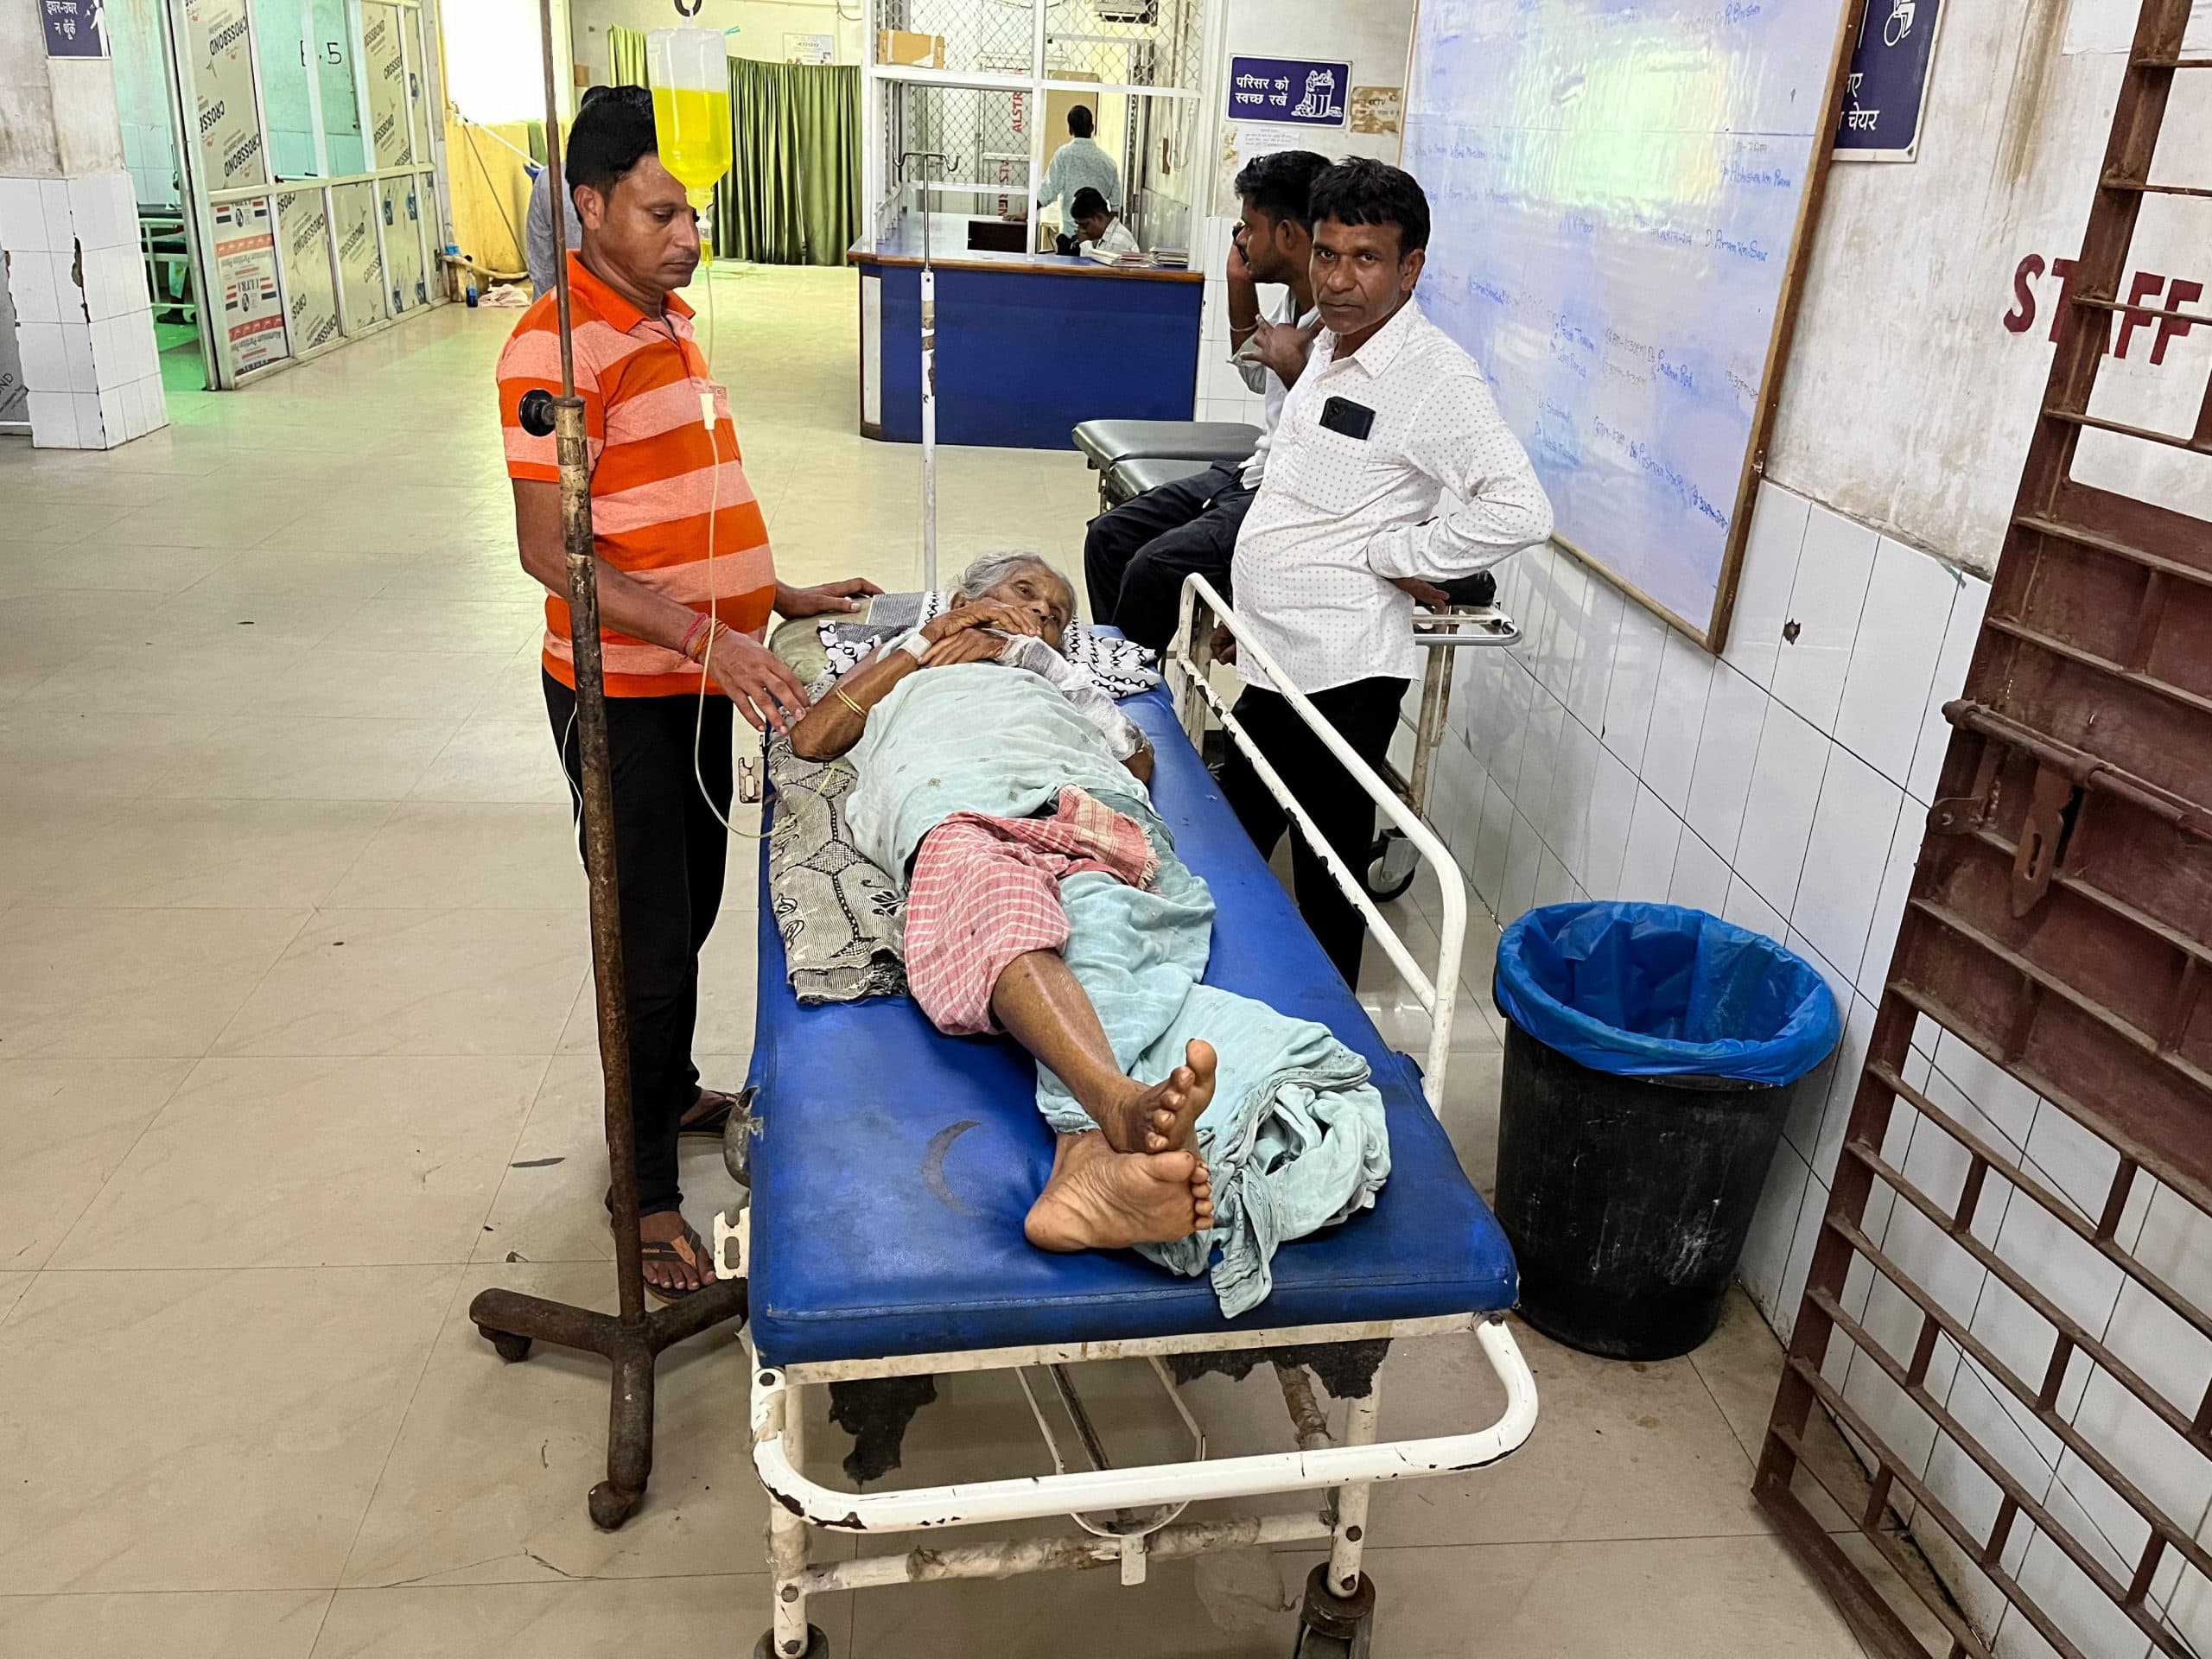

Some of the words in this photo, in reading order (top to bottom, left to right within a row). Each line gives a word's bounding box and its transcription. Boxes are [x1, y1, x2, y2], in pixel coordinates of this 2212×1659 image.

[54, 22, 61, 35] न
[209, 16, 249, 56] CROSSBOND
[1236, 74, 1269, 89] परिसर
[1274, 76, 1289, 91] को
[1235, 92, 1264, 105] स्वच्छ
[1268, 92, 1287, 106] रखें
[1848, 101, 1880, 130] चेयर
[2003, 253, 2203, 366] STFF
